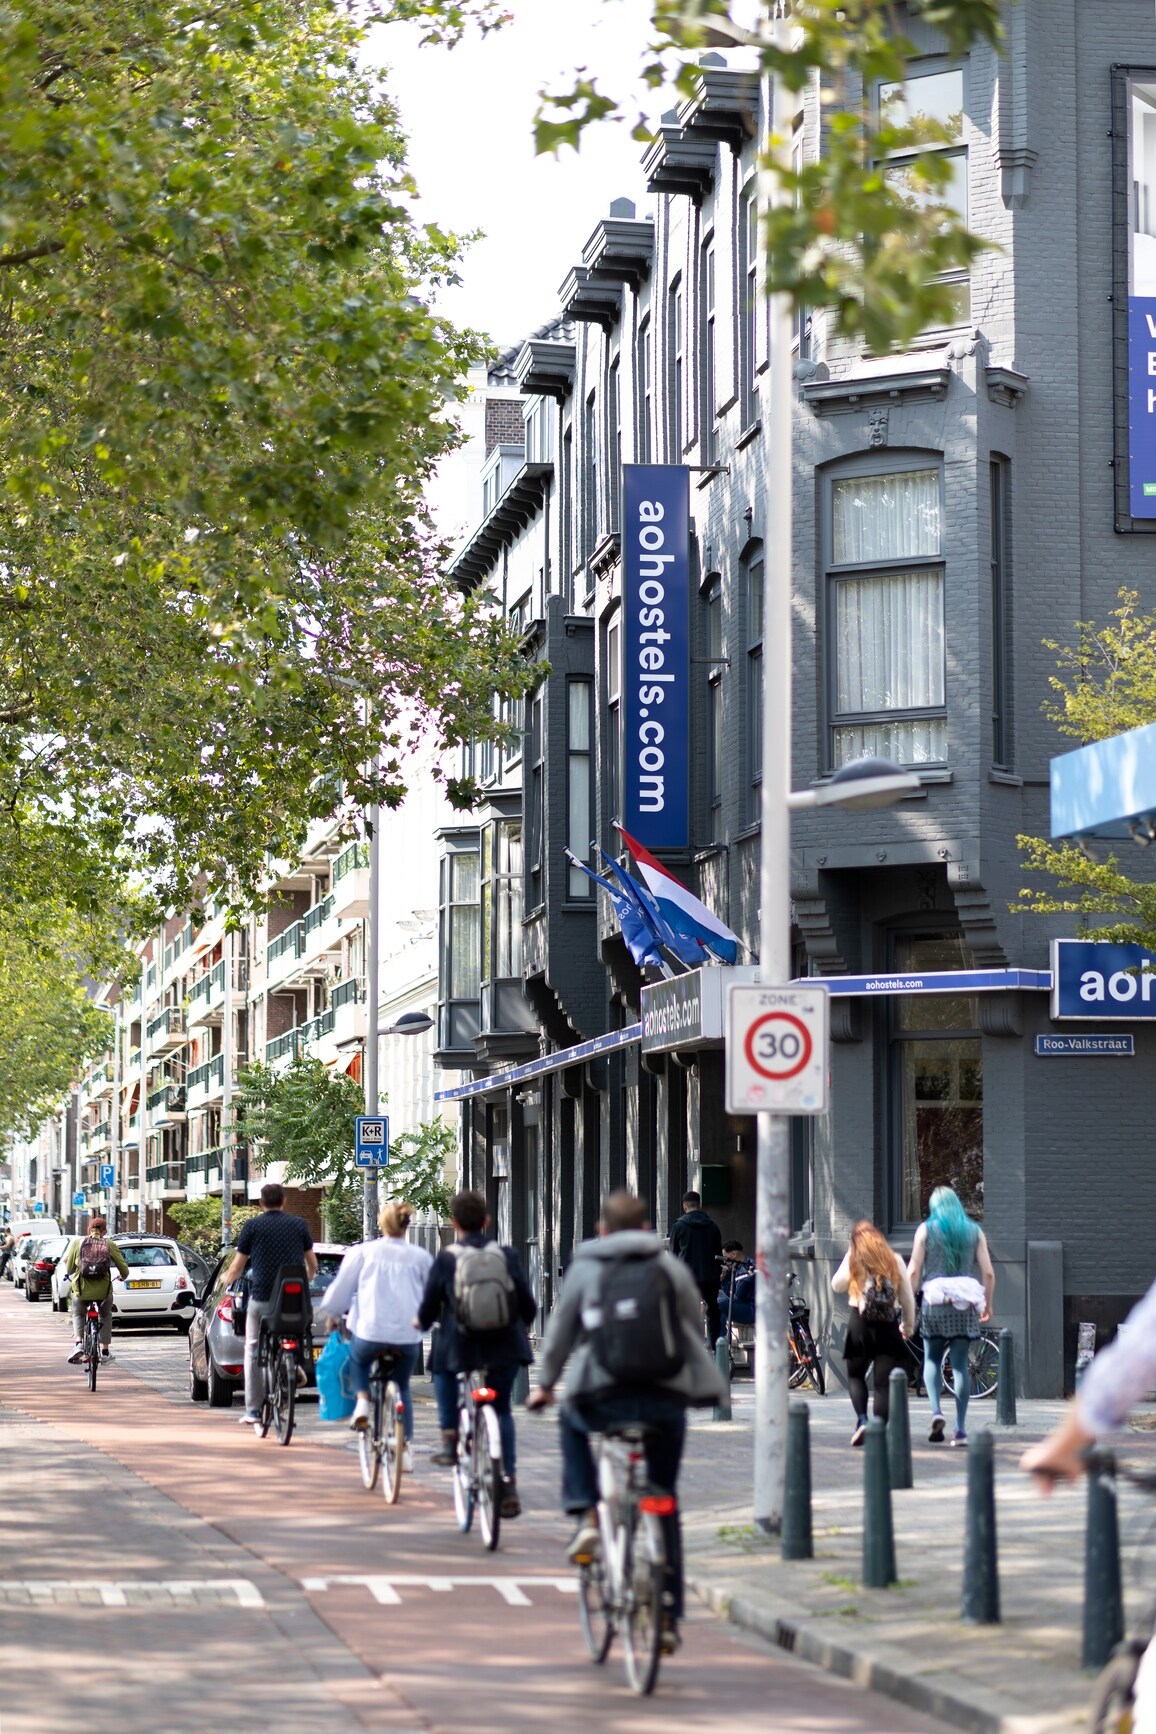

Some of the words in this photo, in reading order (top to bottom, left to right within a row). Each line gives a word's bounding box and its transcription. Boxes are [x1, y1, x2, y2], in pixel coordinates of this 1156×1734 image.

[638, 500, 675, 813] aohostels.com
[866, 979, 923, 990] aohostels.com
[759, 994, 797, 1006] ZONE
[645, 993, 700, 1038] aohostels.com
[758, 1032, 799, 1059] 30
[362, 1126, 382, 1137] K+R
[103, 1166, 112, 1179] P
